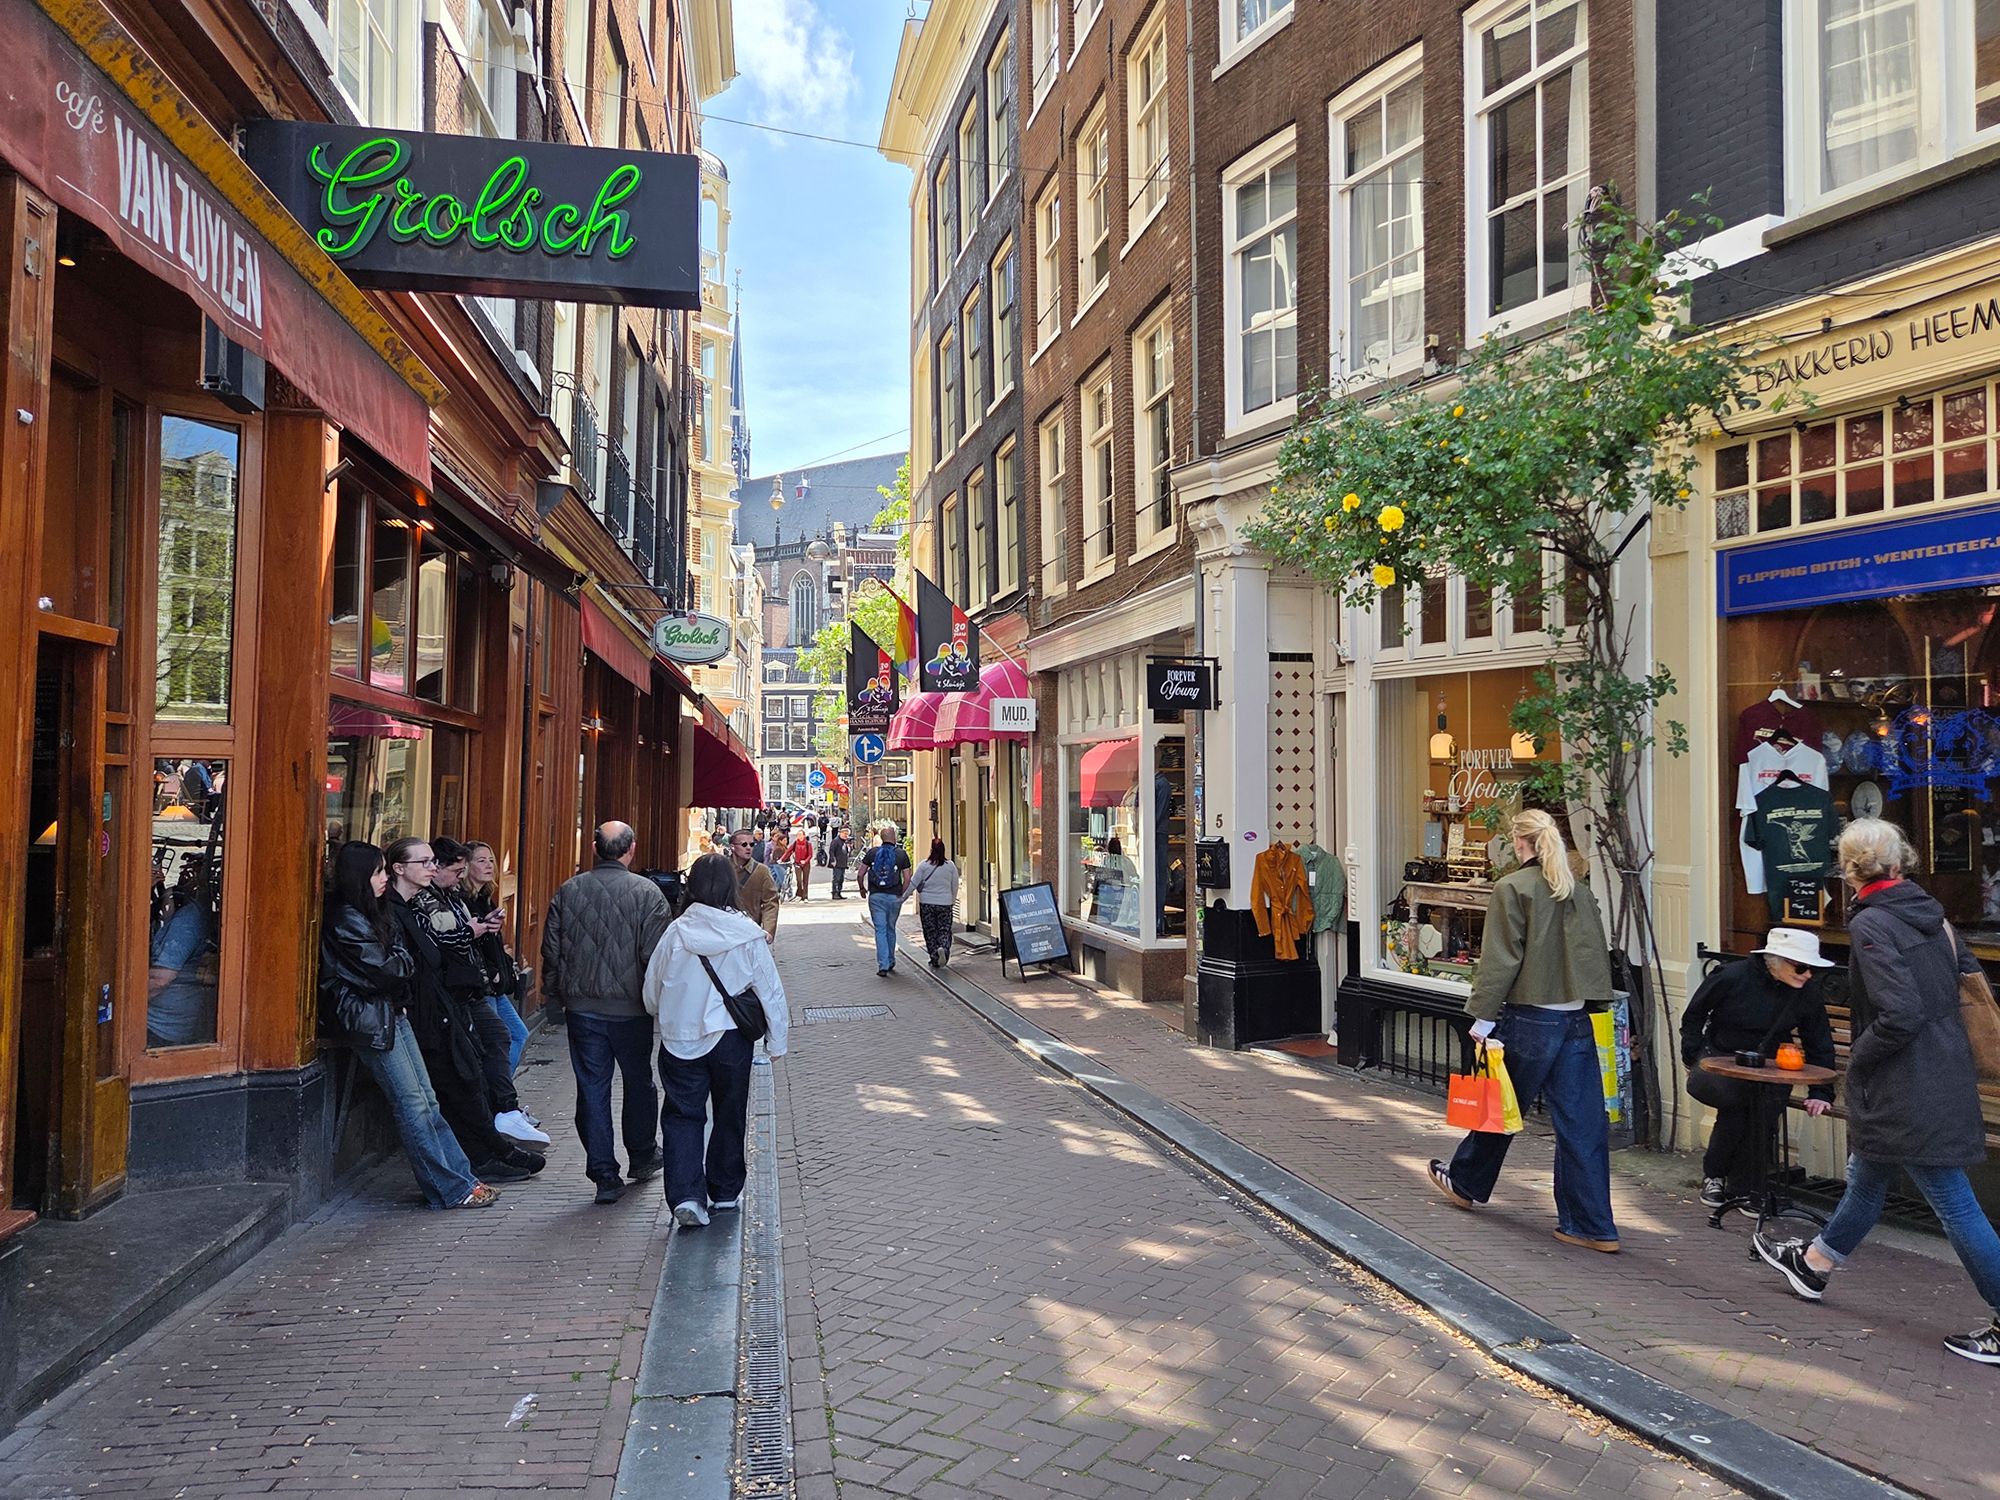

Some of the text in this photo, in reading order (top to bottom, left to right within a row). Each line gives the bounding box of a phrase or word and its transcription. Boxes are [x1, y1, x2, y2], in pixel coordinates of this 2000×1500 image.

[56, 81, 263, 330] café VAN ZUYLEN
[306, 137, 643, 261] Grolsch
[1737, 565, 1808, 585] FLIPPING
[1809, 556, 1862, 574] BITCH
[662, 624, 721, 647] Grolsch
[954, 622, 966, 633] 30
[1167, 669, 1196, 682] FOREVER
[1159, 679, 1201, 700] Young
[1001, 705, 1030, 721] MUD.
[1460, 748, 1513, 770] FOREVER
[1215, 813, 1223, 829] 5
